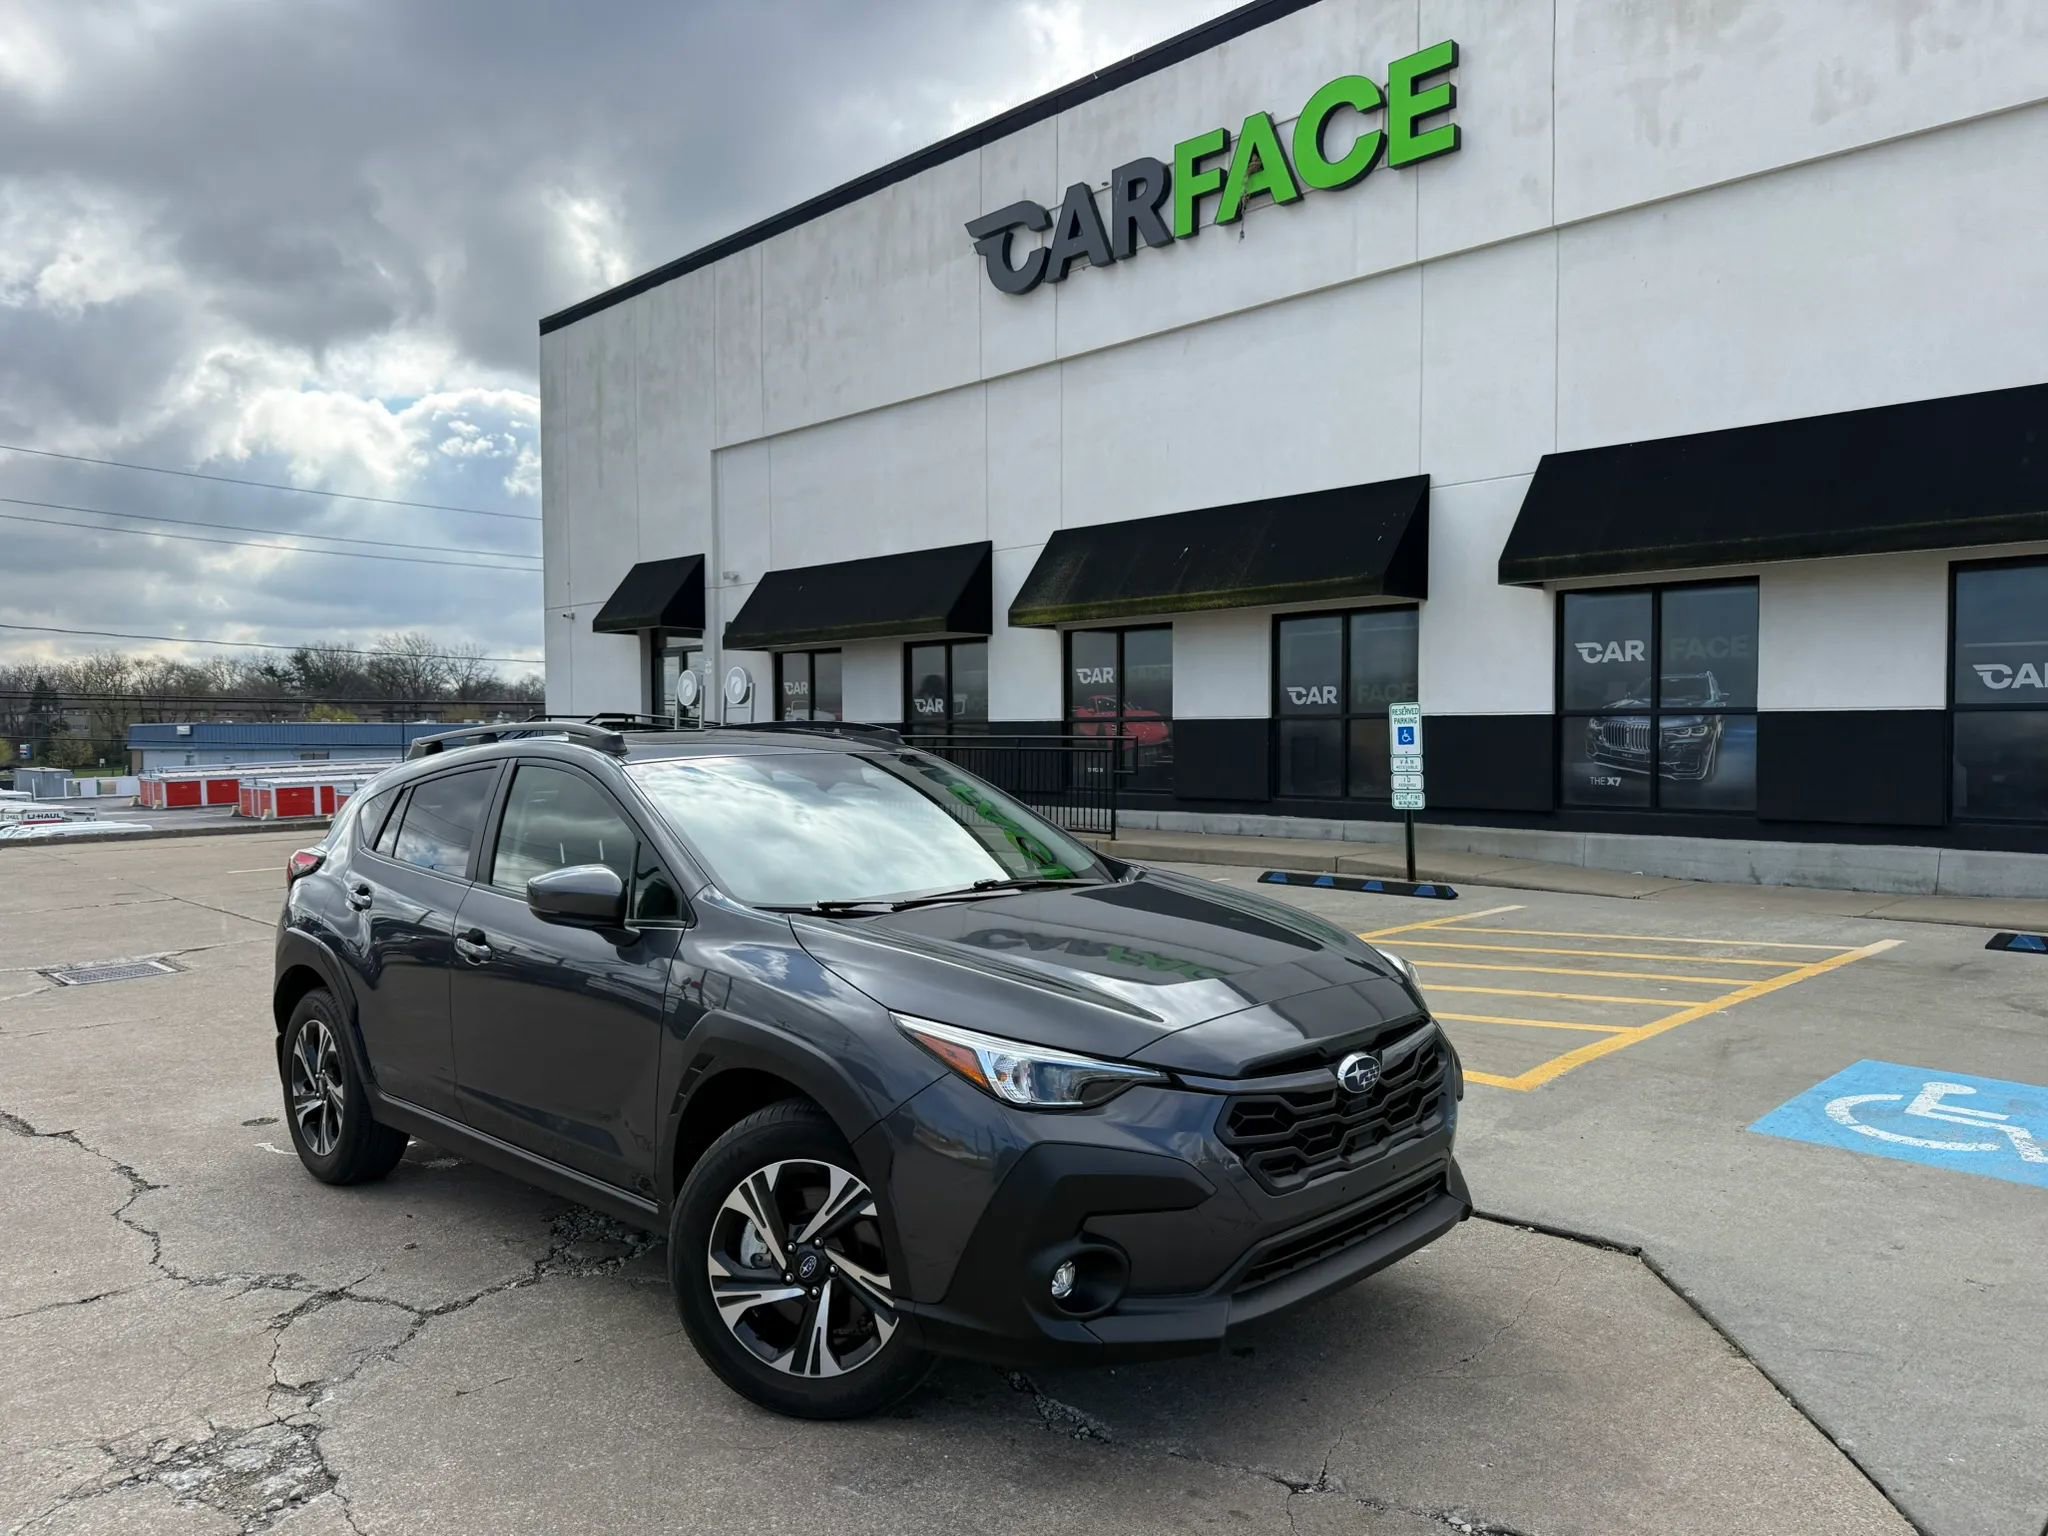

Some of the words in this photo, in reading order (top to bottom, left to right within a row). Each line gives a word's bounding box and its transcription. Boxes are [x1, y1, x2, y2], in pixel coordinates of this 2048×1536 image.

[964, 39, 1461, 295] CARFACE
[1574, 639, 1645, 663] CAR
[1076, 667, 1114, 684] CAR
[1972, 662, 2048, 689] CA
[784, 681, 808, 695] CAR
[1287, 685, 1337, 705] CAR
[914, 698, 944, 713] CAR
[1392, 708, 1419, 716] RESERVED
[1590, 776, 1606, 786] THE
[1607, 777, 1622, 787] X7
[27, 812, 62, 820] U-HAUL
